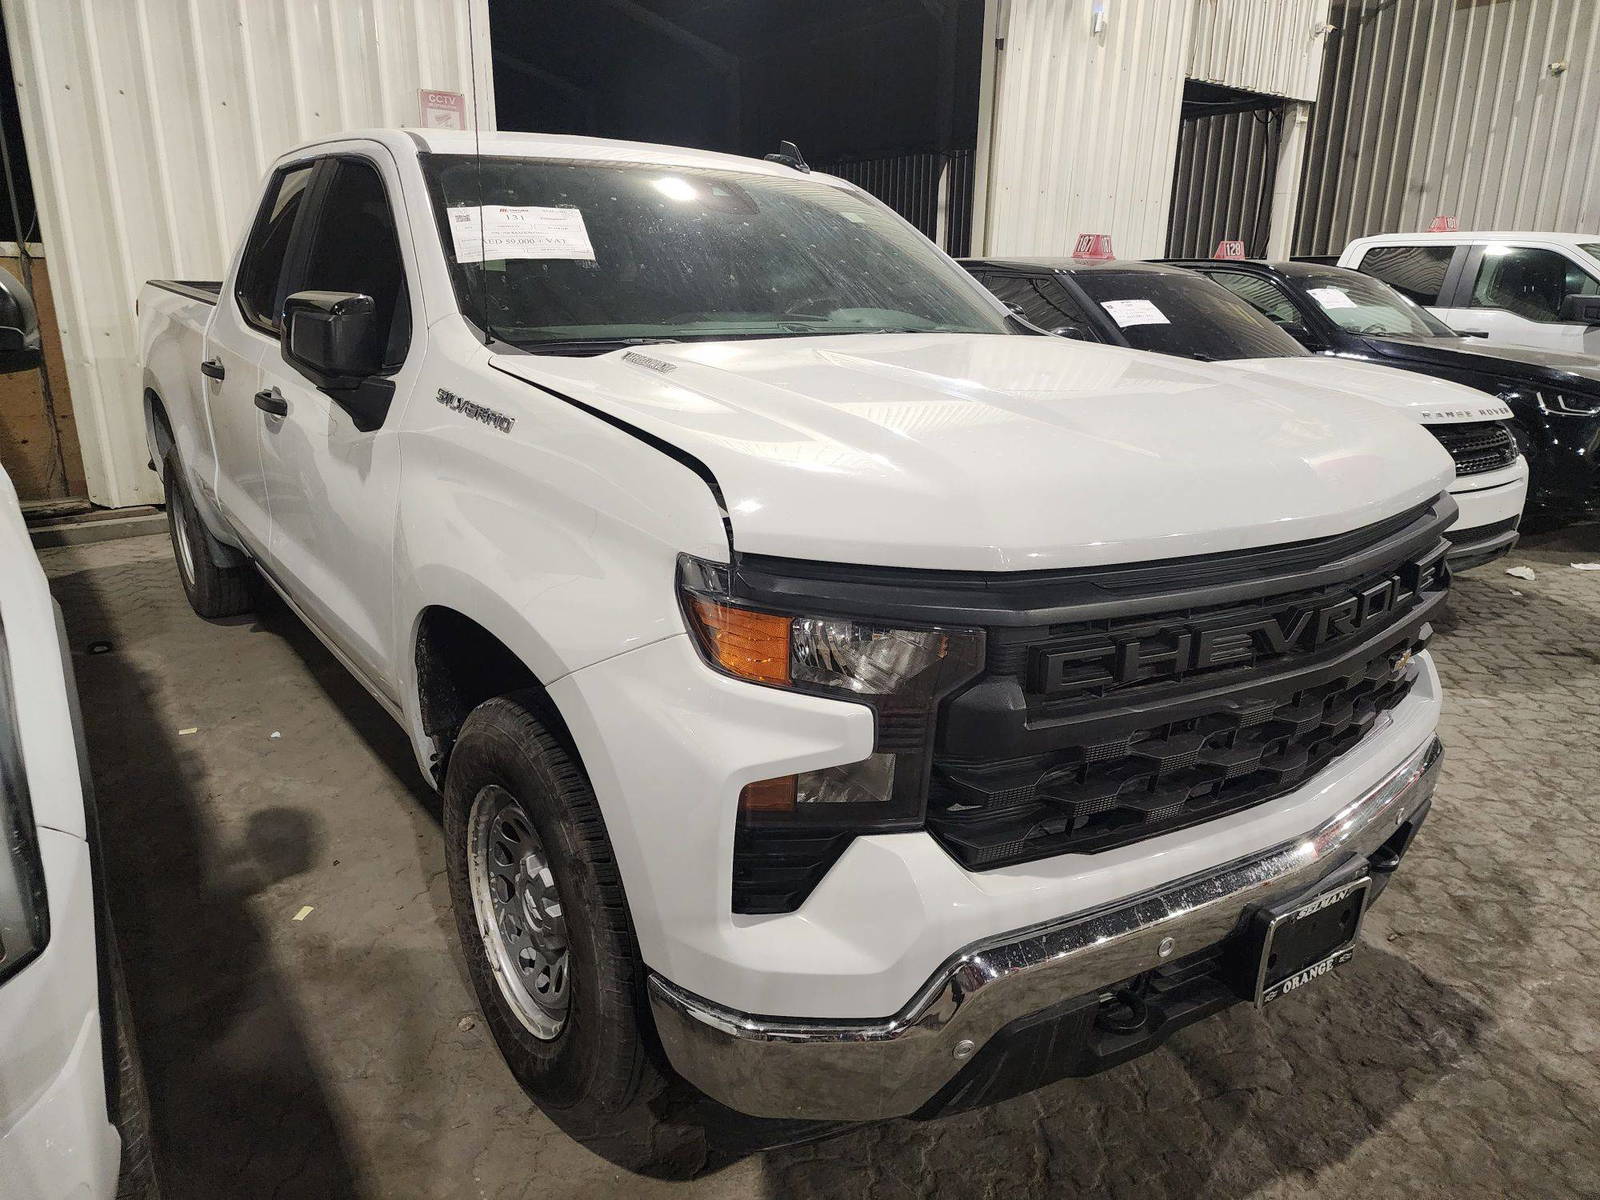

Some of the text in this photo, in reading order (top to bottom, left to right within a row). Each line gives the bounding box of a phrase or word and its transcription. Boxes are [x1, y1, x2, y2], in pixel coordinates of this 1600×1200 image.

[428, 94, 456, 104] CCTV
[1077, 235, 1095, 252] 187
[1226, 242, 1241, 256] 128
[435, 388, 516, 433] SILVERADO
[1422, 407, 1510, 419] RANGE ROVER
[1282, 960, 1334, 993] ORANGE
